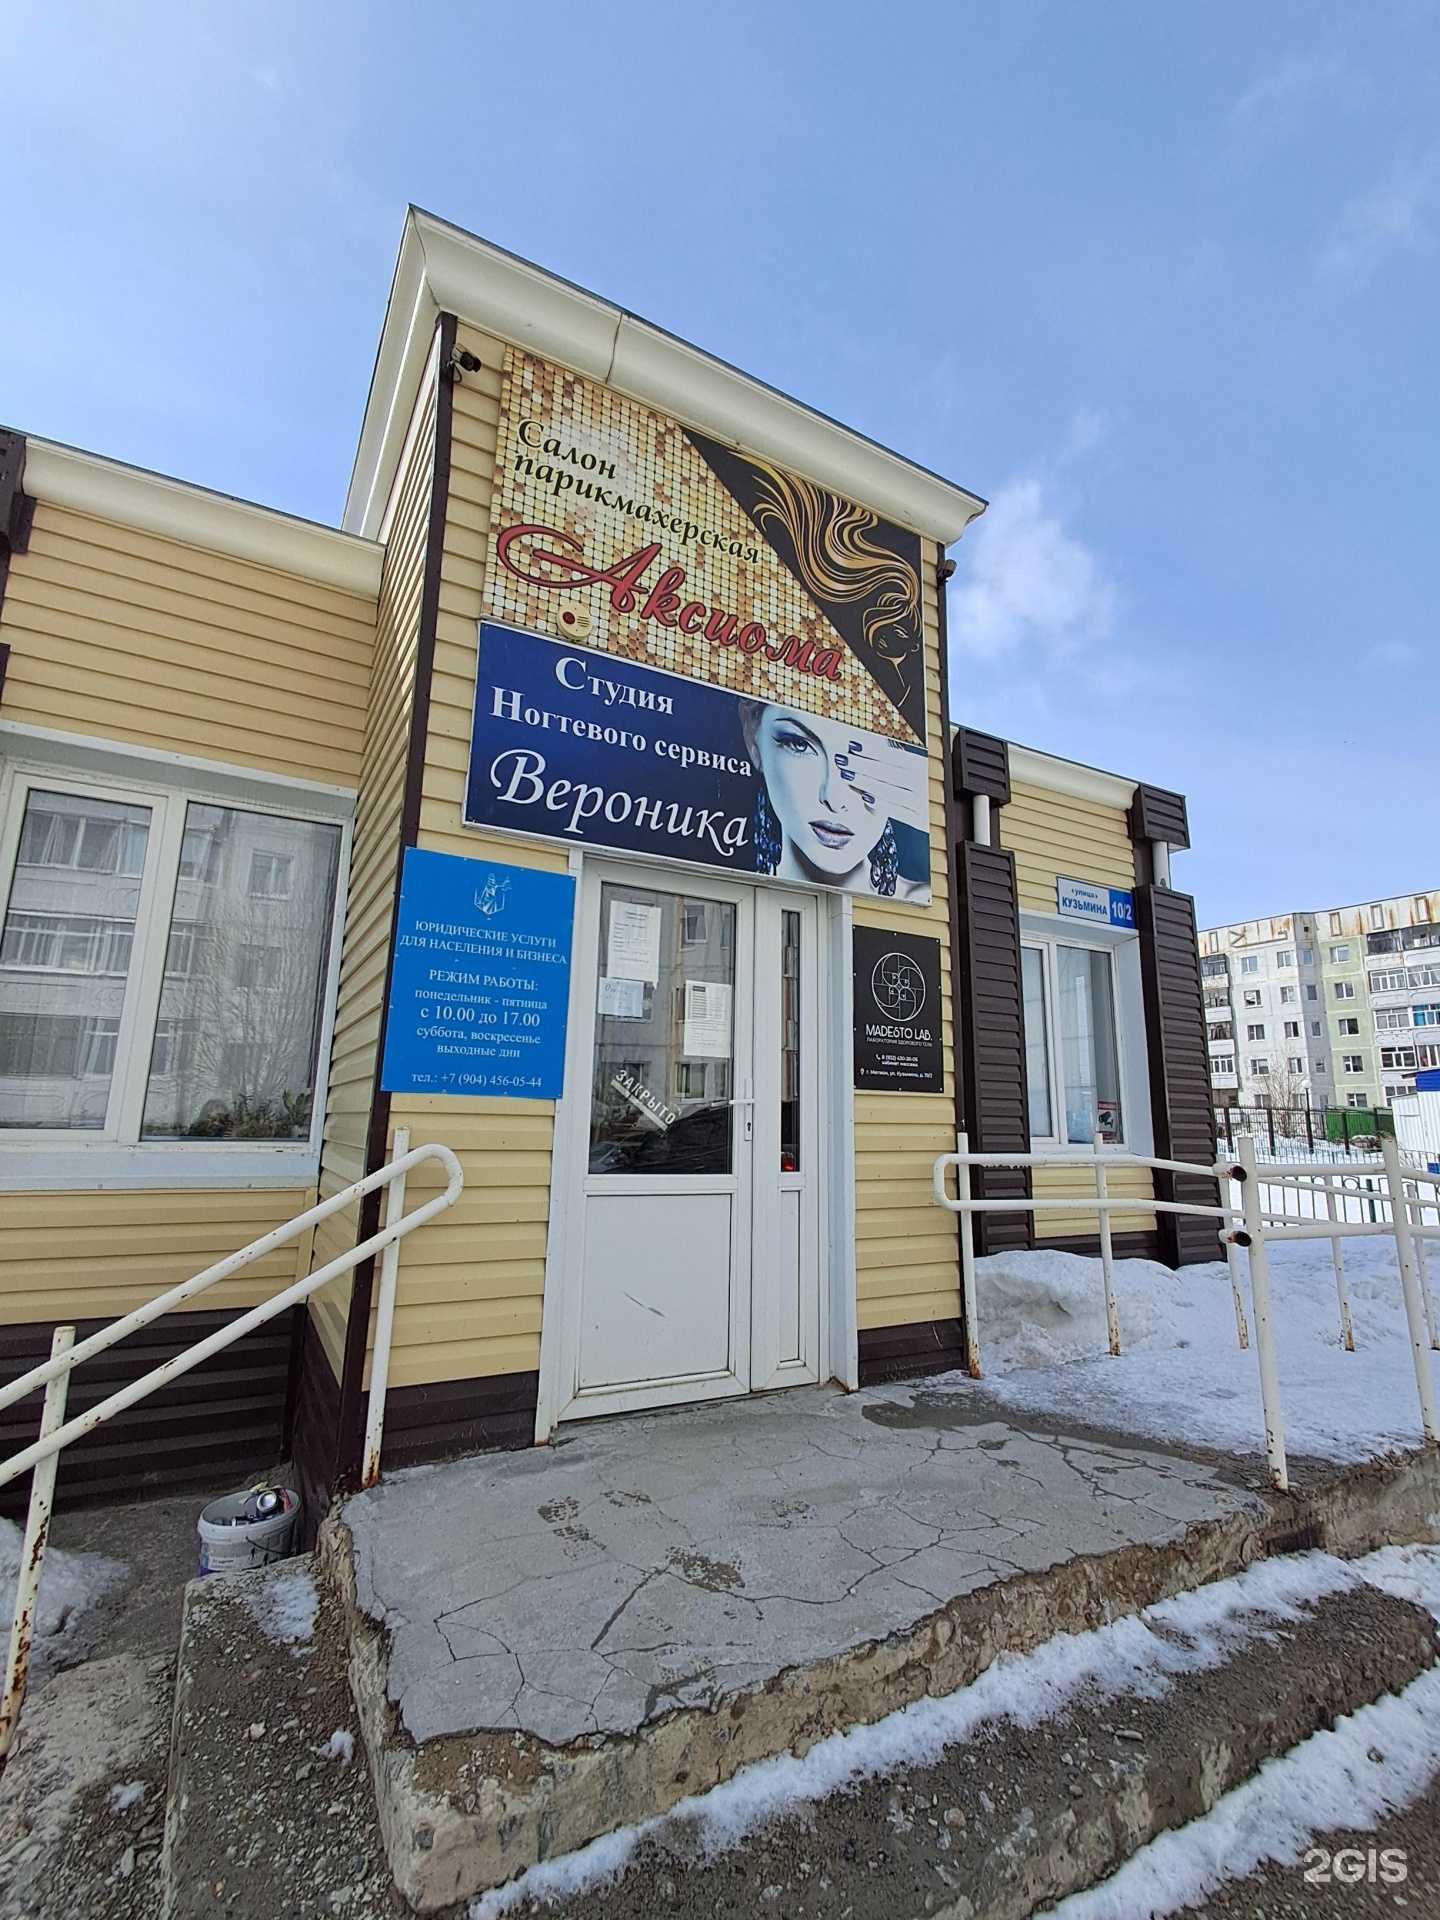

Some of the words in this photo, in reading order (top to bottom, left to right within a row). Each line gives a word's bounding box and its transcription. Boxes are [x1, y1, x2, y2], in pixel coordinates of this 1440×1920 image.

[519, 419, 616, 479] Салон
[514, 451, 760, 564] парикмахерская
[496, 524, 844, 681] Аксиома
[555, 657, 673, 715] Студия
[489, 687, 646, 752] Ногтевого
[655, 739, 752, 776] сервиса
[490, 749, 749, 857] Вероника
[1062, 897, 1108, 915] КУЗЬМИНА
[1112, 901, 1132, 920] 10/2
[415, 921, 508, 941] ЮРИДИЧЕСКИЕ
[512, 934, 556, 947] УСЛУГИ
[400, 936, 426, 947] ДЛЯ
[429, 940, 502, 957] НАСЕЛЕНИЯ
[506, 947, 513, 957] И
[517, 950, 567, 964] БИЗНЕСА
[429, 970, 480, 984] РЕЖИМ
[483, 976, 538, 991] РАБОТЫ:
[415, 990, 491, 1005] понедельник
[502, 998, 547, 1010] пятница
[421, 1009, 429, 1017] с
[435, 1006, 474, 1022] 10.00
[479, 1013, 496, 1024] до
[503, 1012, 540, 1026] 17.00
[417, 1027, 467, 1040] суббота,
[471, 1031, 540, 1044] воскресенье
[915, 1029, 932, 1041] LAB.
[437, 1044, 496, 1057] выходные
[499, 1047, 520, 1058] дни
[412, 1072, 437, 1083] тел.:
[441, 1073, 455, 1083] +7
[458, 1074, 487, 1086] (904)
[490, 1075, 542, 1088] 456-05-44
[616, 1070, 676, 1124] ЗАКРЫТО
